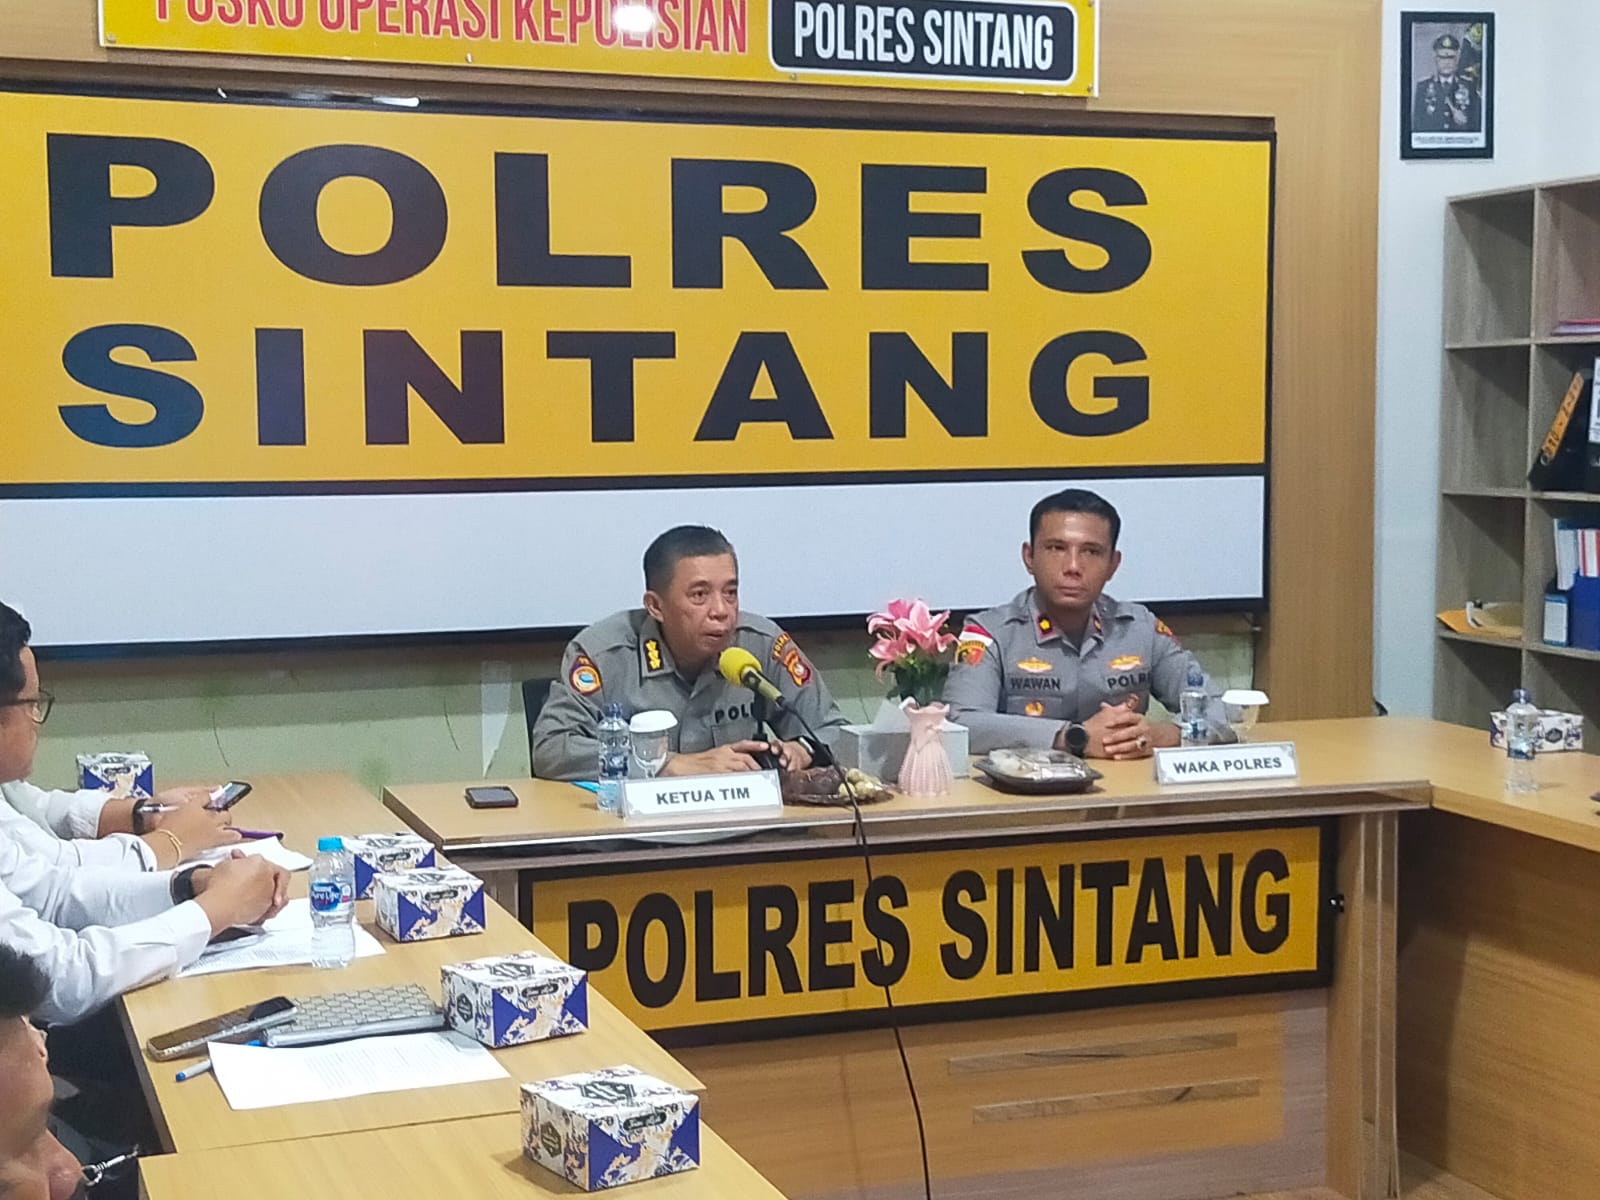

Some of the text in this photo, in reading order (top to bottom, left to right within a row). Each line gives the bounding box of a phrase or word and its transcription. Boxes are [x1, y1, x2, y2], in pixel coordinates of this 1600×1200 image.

[320, 0, 499, 39] OPERASI
[795, 1, 1053, 70] POLRES SINTANG
[47, 132, 1151, 294] POLRES
[58, 323, 1150, 448] SINTANG
[1010, 677, 1061, 690] WAWAN
[715, 703, 753, 724] POL
[1173, 757, 1282, 774] WAKA POLRES
[656, 787, 750, 805] KETUA TIM
[568, 848, 1290, 1008] POLRES SINTANG
